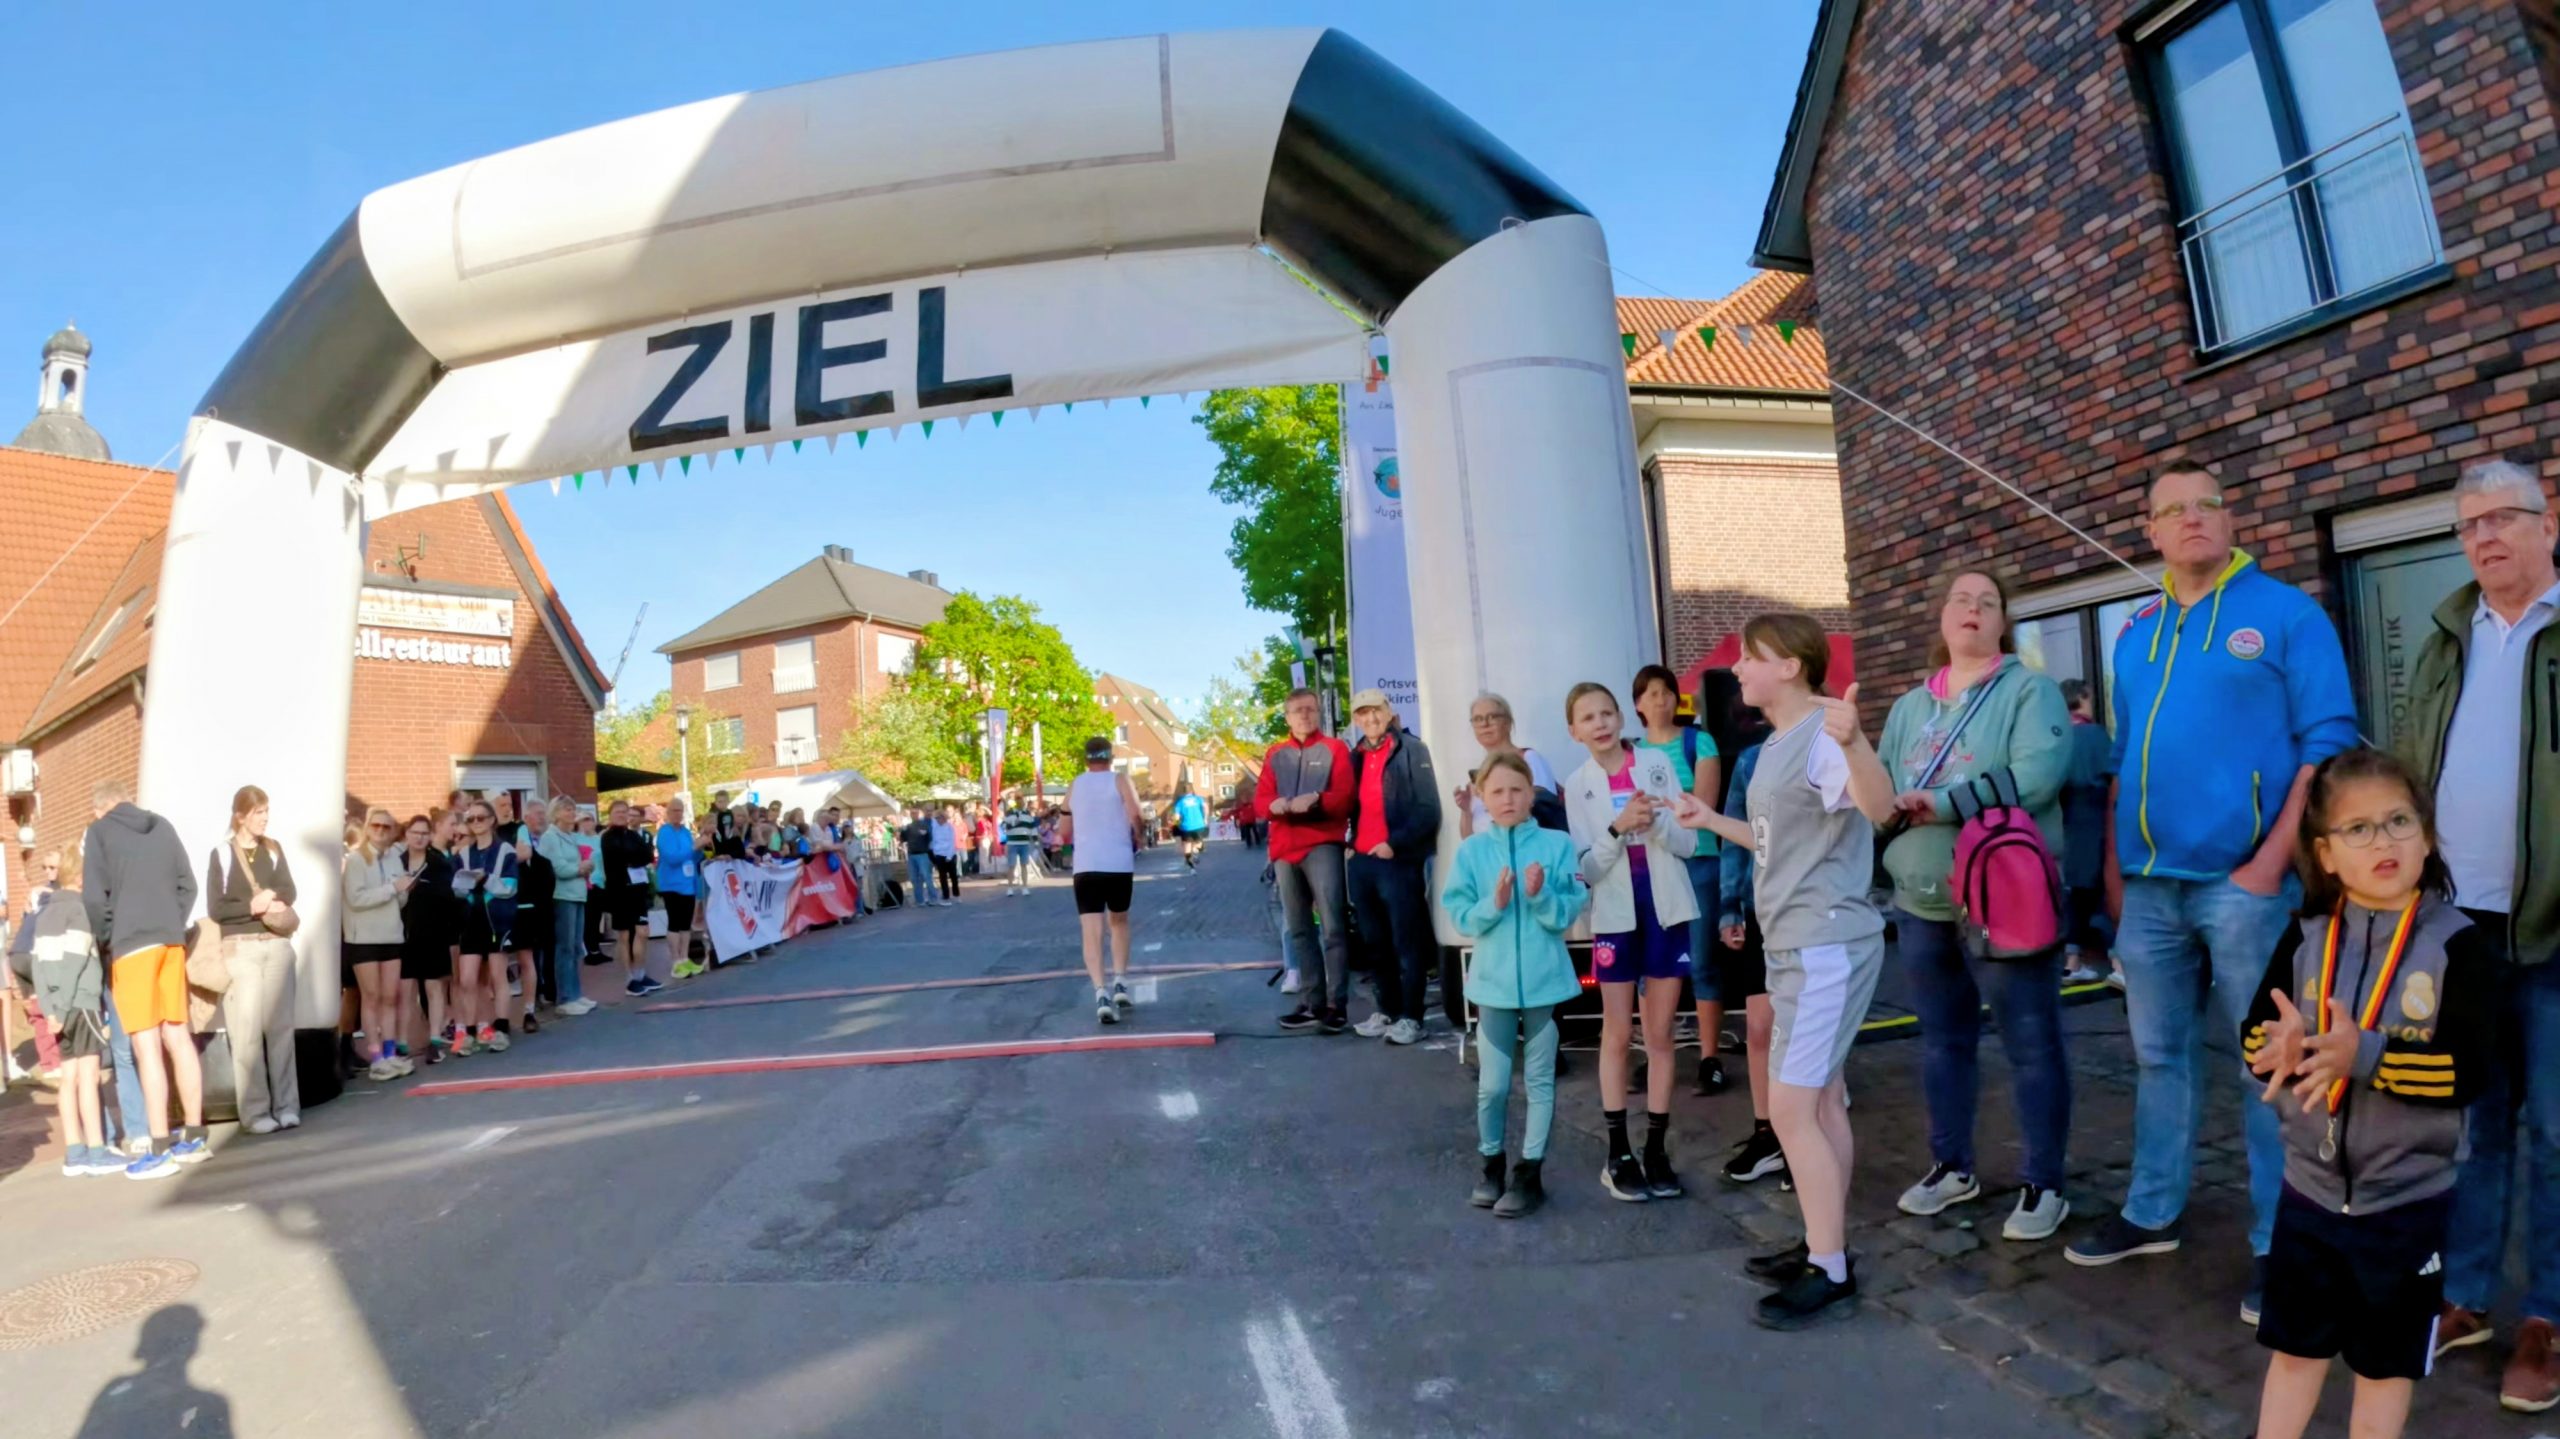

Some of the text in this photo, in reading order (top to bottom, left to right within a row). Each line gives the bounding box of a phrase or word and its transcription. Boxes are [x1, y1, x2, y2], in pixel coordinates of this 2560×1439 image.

[629, 286, 1014, 452] ZIEL
[1386, 693, 1419, 704] kirch
[2386, 616, 2407, 745] ROTHETIK
